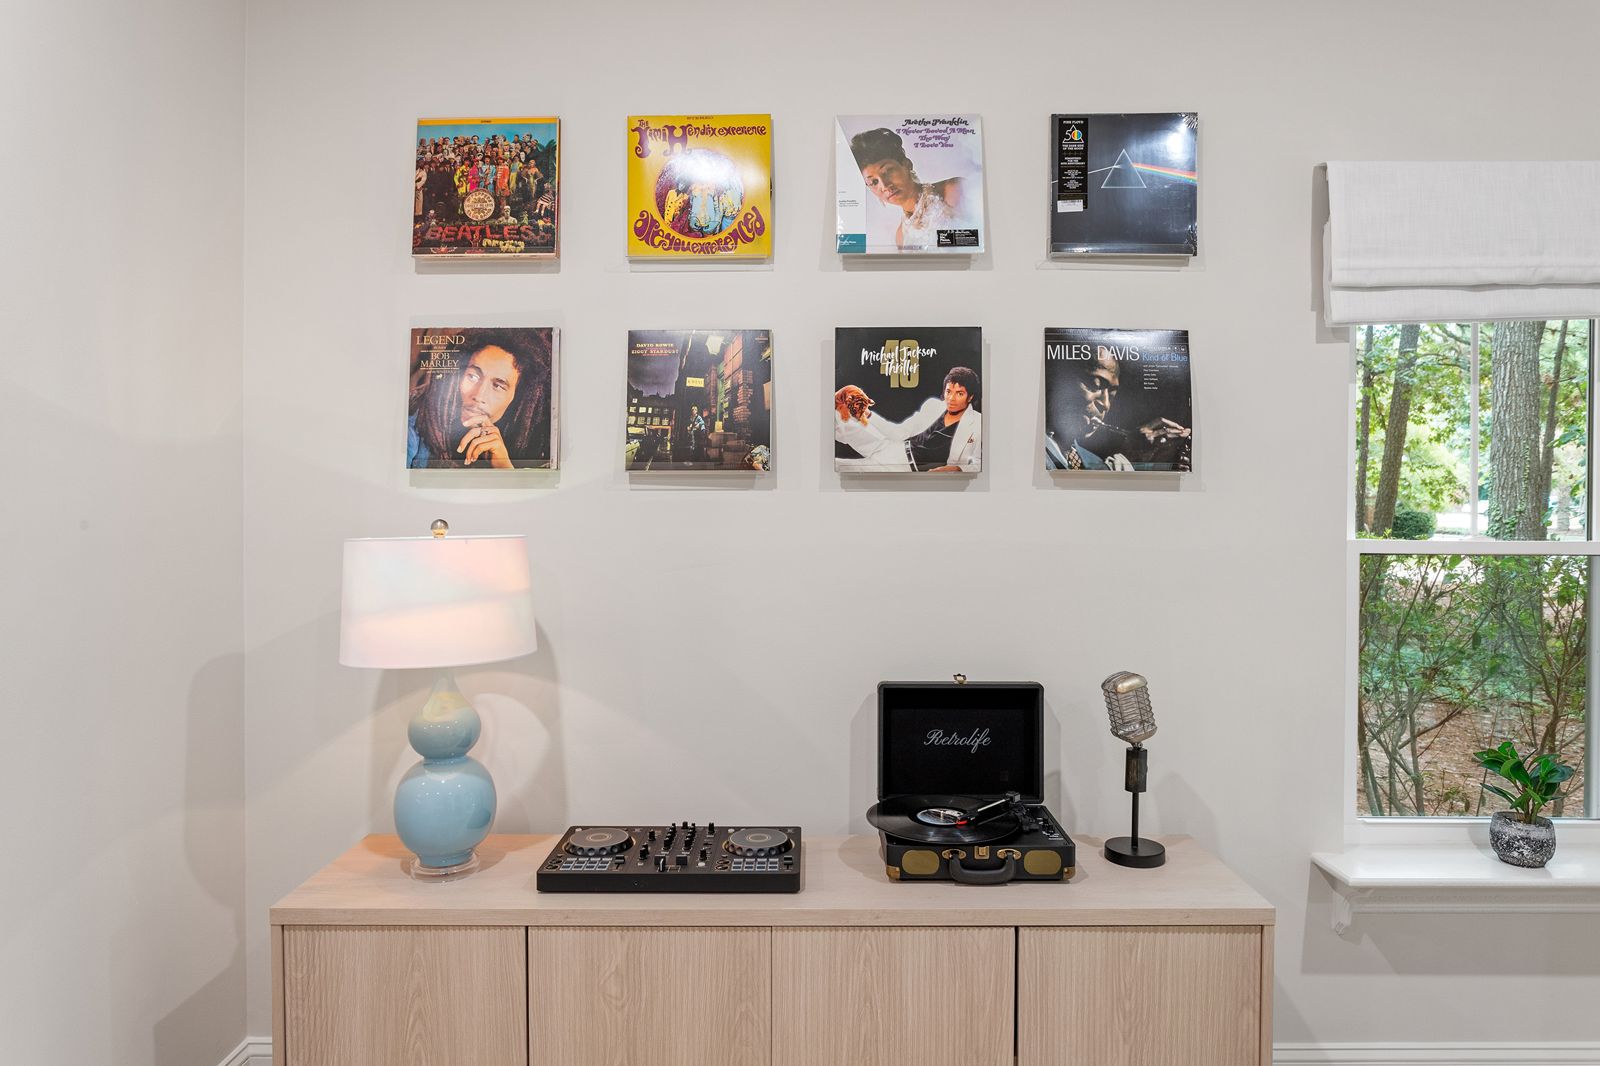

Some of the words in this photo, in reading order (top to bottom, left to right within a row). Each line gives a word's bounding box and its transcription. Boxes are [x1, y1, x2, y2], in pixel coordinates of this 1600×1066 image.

[902, 118, 931, 127] Aretha
[932, 117, 969, 126] Franklin
[425, 224, 534, 241] BEATLES
[416, 335, 466, 345] LEGEND
[431, 352, 450, 360] BOB
[861, 346, 899, 365] Michael
[899, 345, 937, 361] Jackson
[1047, 344, 1092, 360] MILES
[1097, 345, 1140, 361] DAVIS
[1142, 352, 1159, 361] Kind
[1170, 352, 1188, 362] Blue
[420, 359, 459, 368] MARLEY
[881, 359, 920, 376] Thriller
[923, 727, 992, 754] Retrolife
